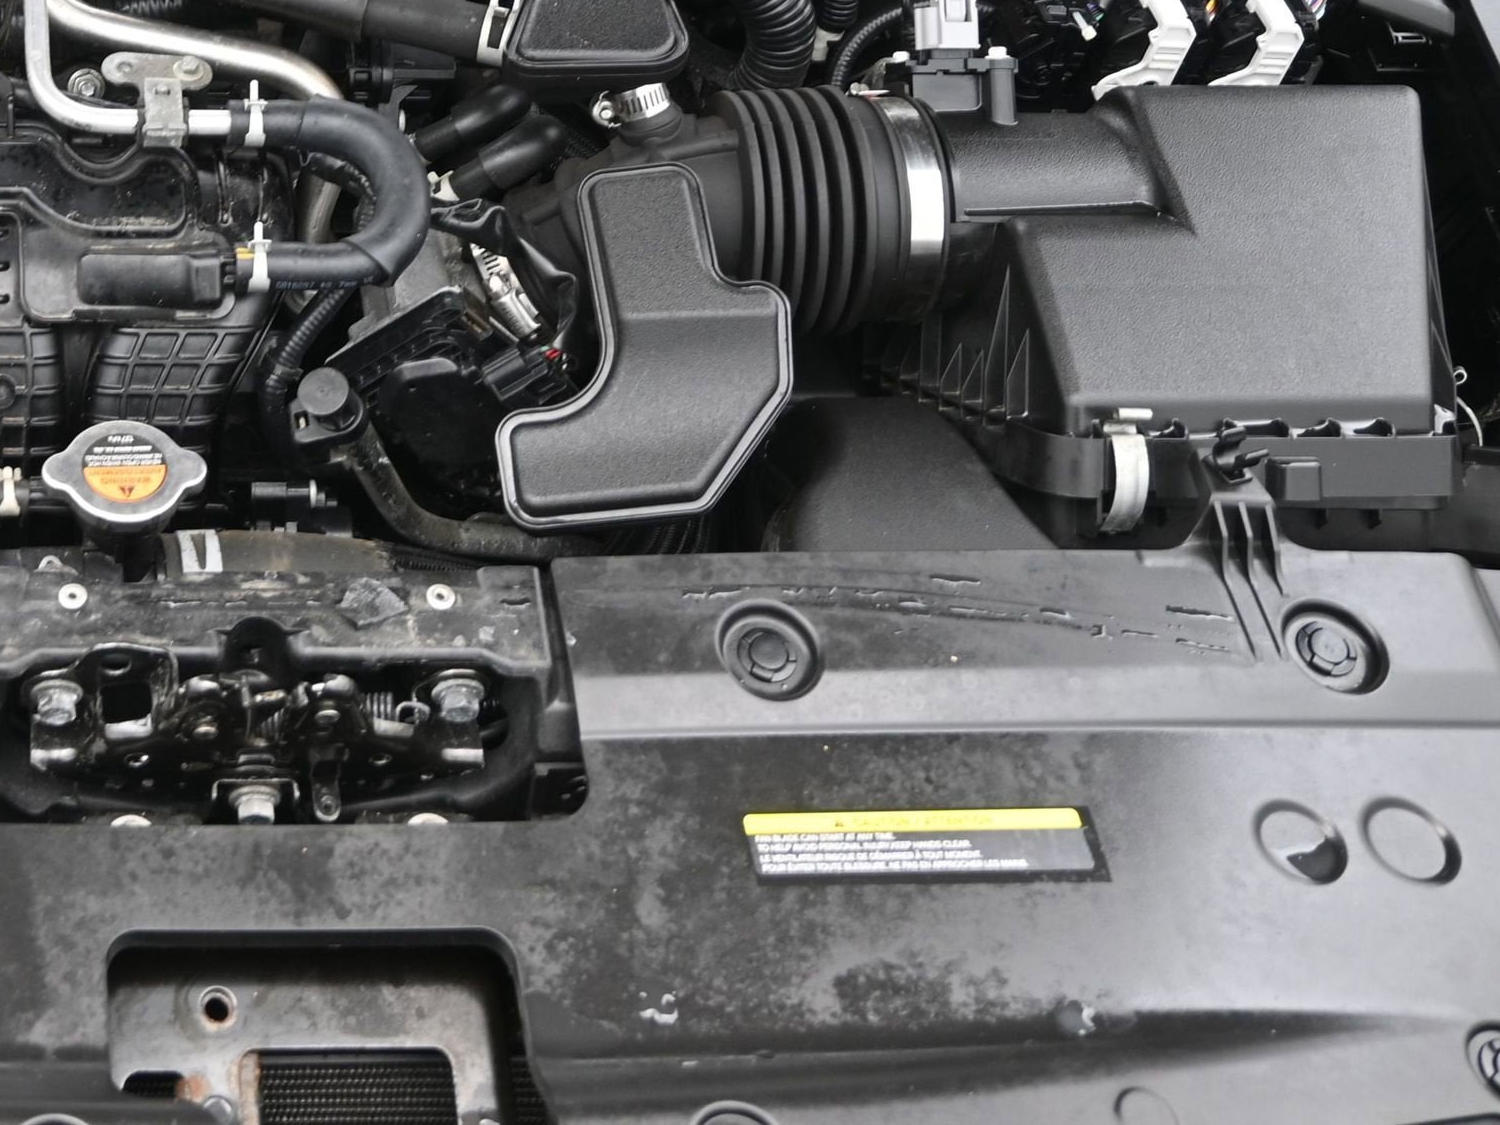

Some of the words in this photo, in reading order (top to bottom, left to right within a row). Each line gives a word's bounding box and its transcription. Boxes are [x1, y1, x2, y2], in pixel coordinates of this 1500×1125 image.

[757, 843, 770, 853] TO
[771, 843, 792, 852] HELP
[760, 854, 772, 863] LE
[762, 864, 787, 873] POUR
